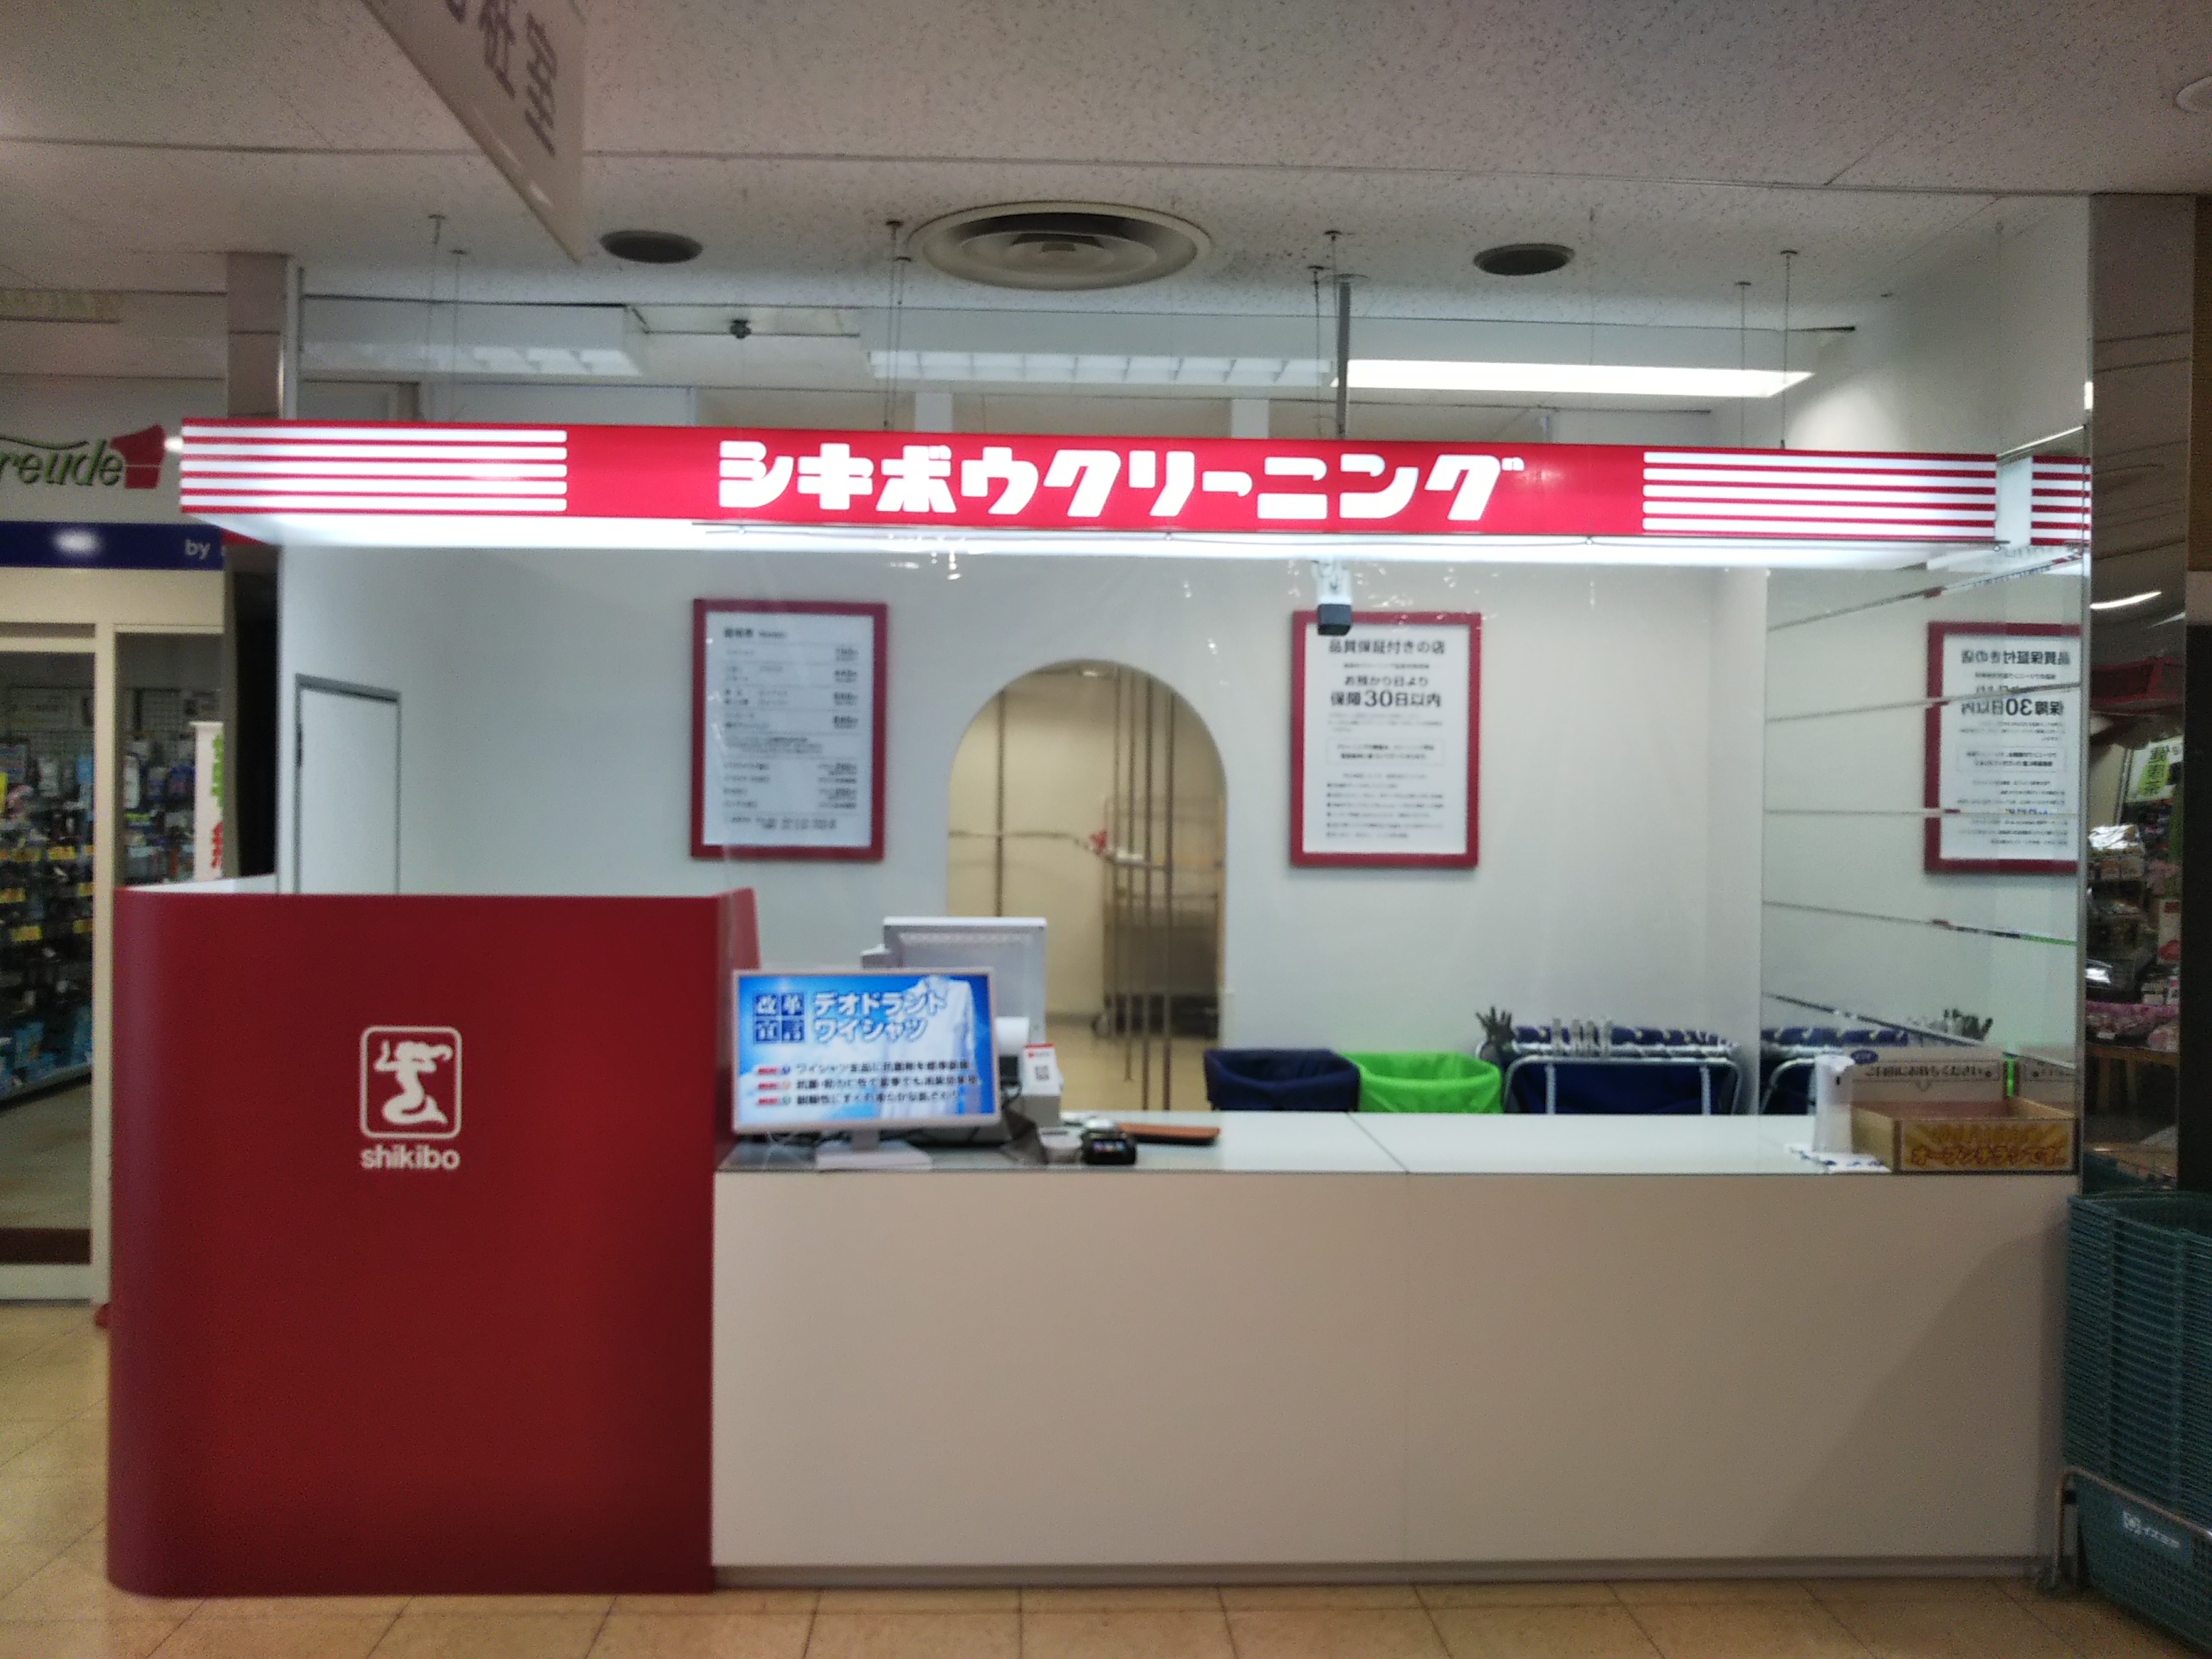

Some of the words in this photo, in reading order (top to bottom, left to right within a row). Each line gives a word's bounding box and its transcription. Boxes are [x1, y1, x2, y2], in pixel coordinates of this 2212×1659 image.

[719, 440, 1525, 520] シキボウクリーニング
[184, 539, 211, 559] by
[815, 991, 947, 1017] デオドラント
[815, 1018, 928, 1043] ワイシャツ
[360, 1144, 462, 1170] shikibo
